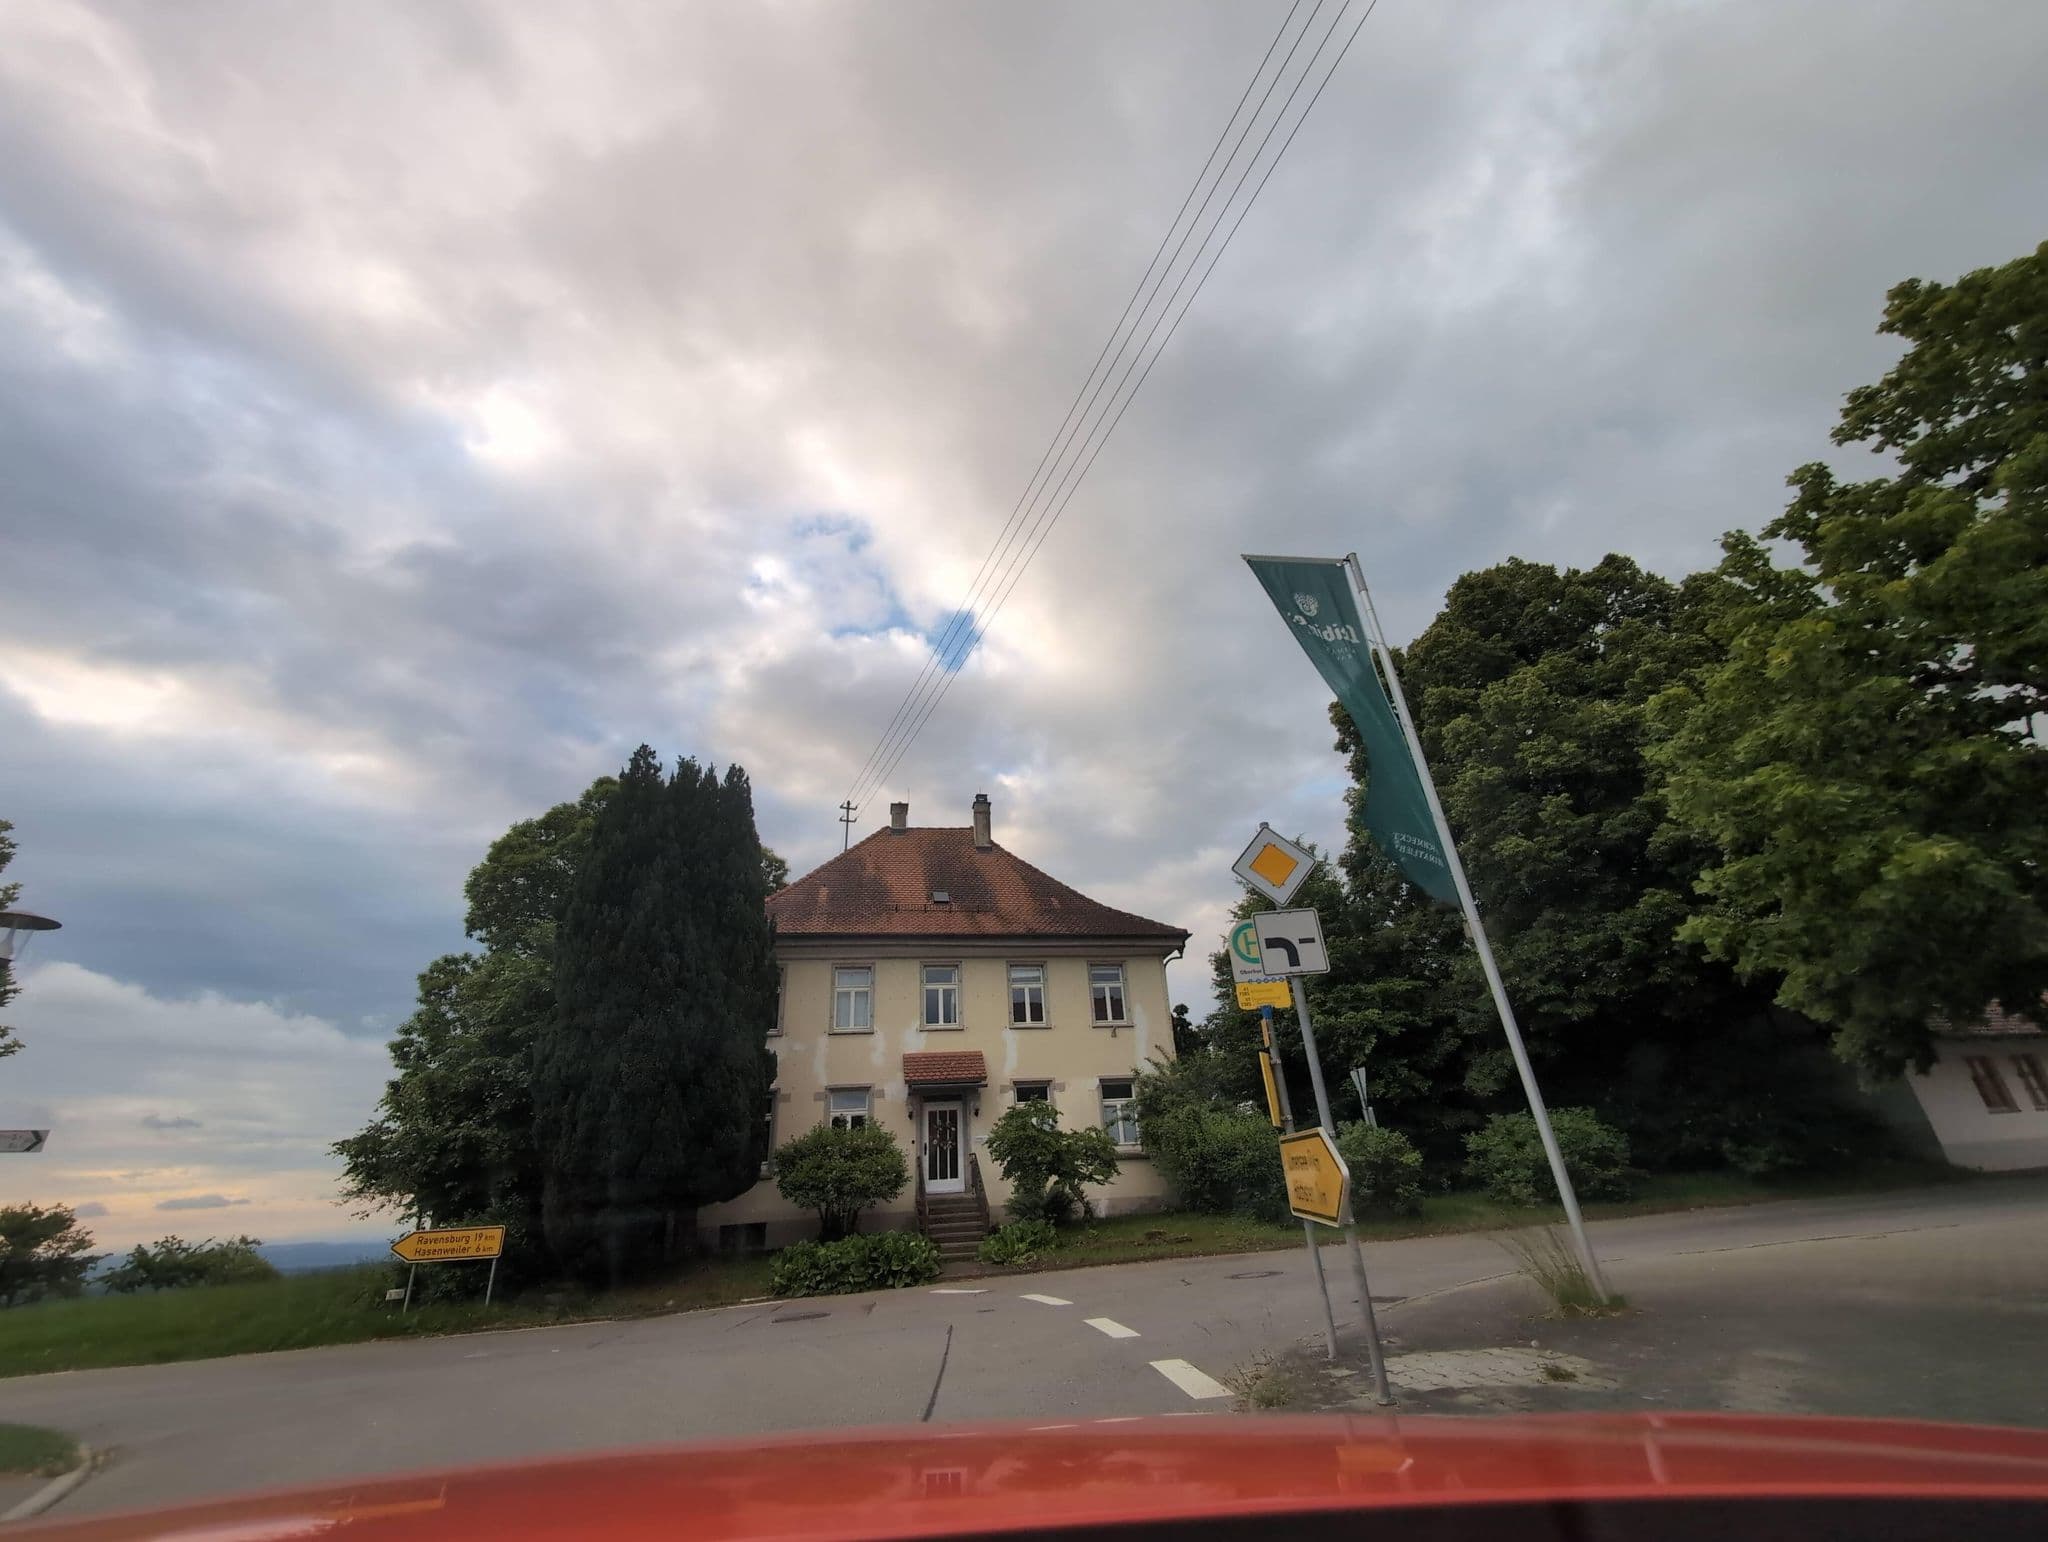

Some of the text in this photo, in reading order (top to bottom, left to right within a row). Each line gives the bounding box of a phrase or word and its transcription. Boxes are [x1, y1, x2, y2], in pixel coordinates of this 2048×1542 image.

[416, 1235, 471, 1245] Ravensburg
[474, 1232, 483, 1242] 19
[414, 1246, 471, 1256] Hasenweiler
[475, 1245, 480, 1253] 6
